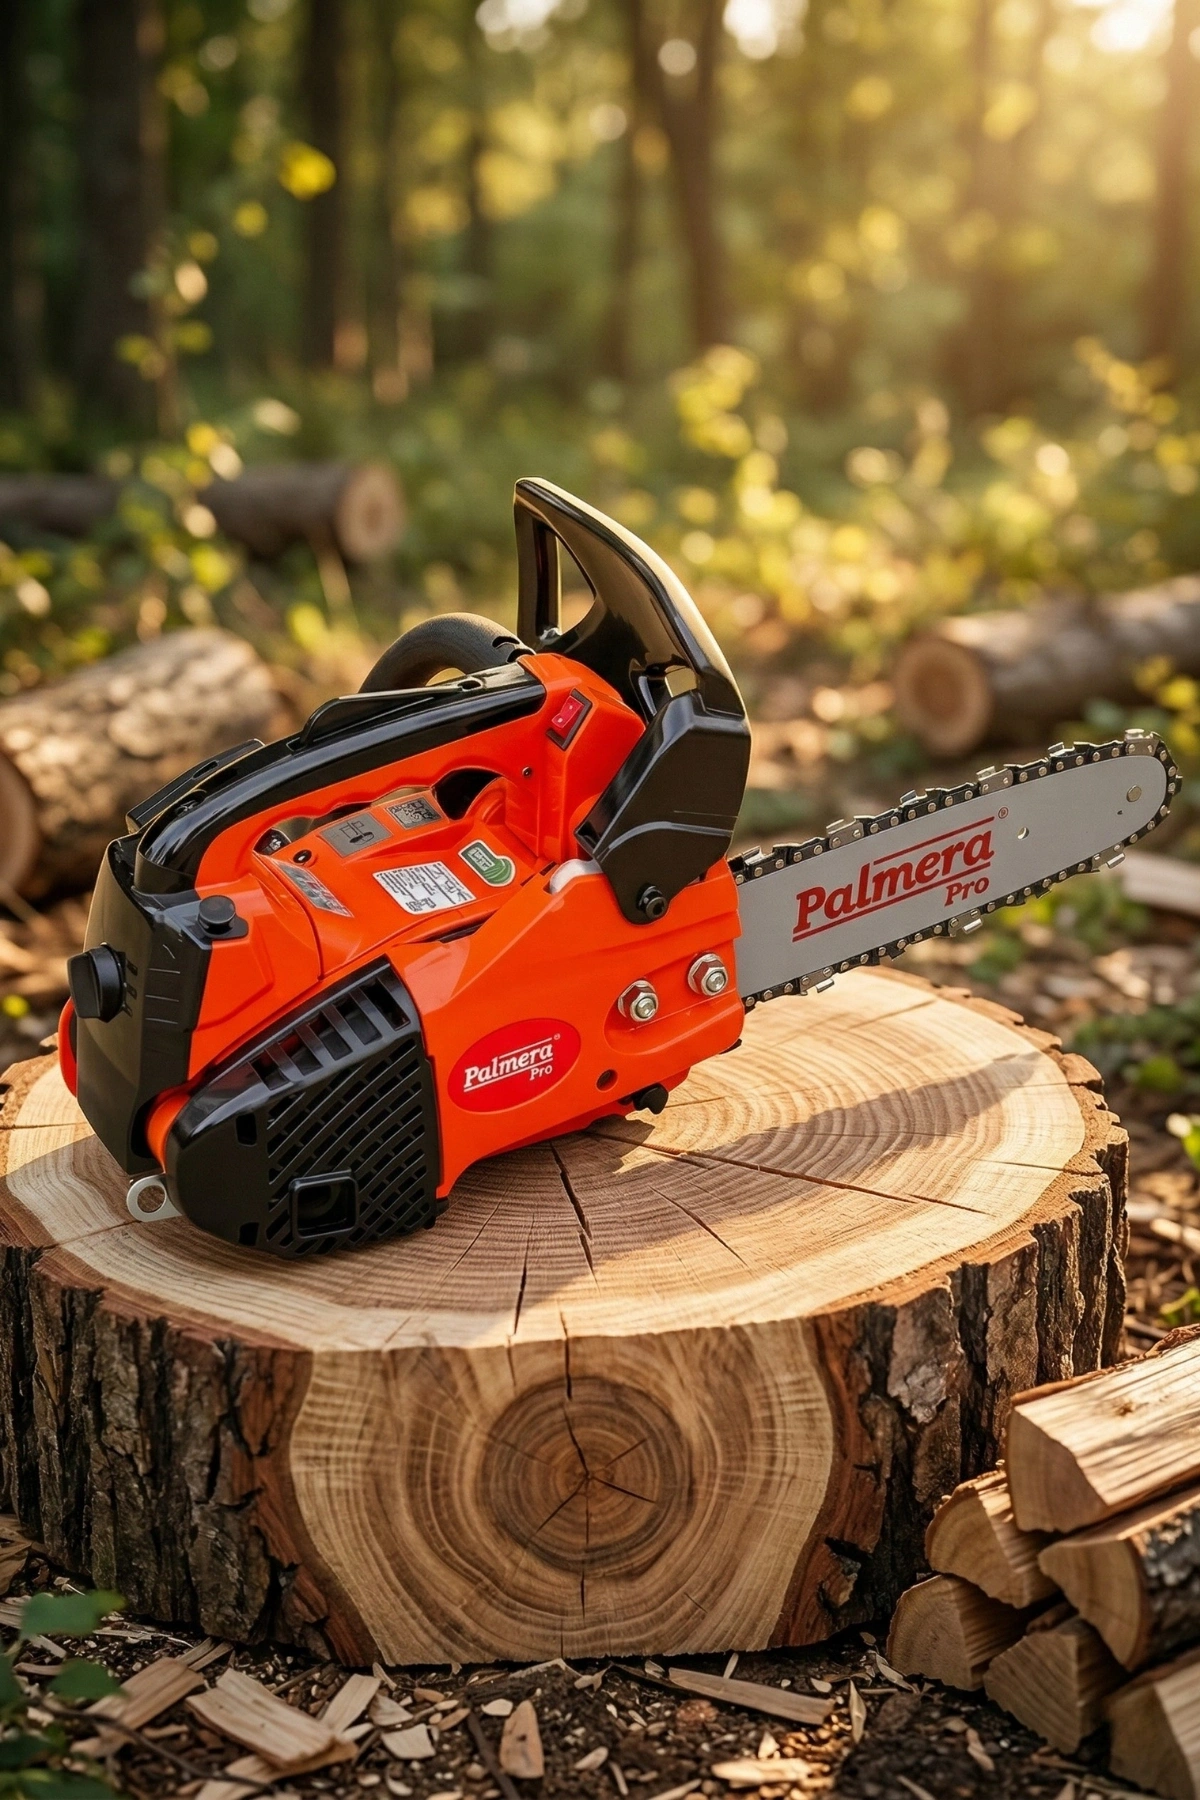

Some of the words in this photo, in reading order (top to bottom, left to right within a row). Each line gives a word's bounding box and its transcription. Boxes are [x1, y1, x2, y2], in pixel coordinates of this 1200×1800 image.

[793, 830, 995, 935] Palmera
[944, 876, 990, 908] Pro
[463, 1043, 554, 1089] Palmera
[529, 1065, 553, 1081] Pro
